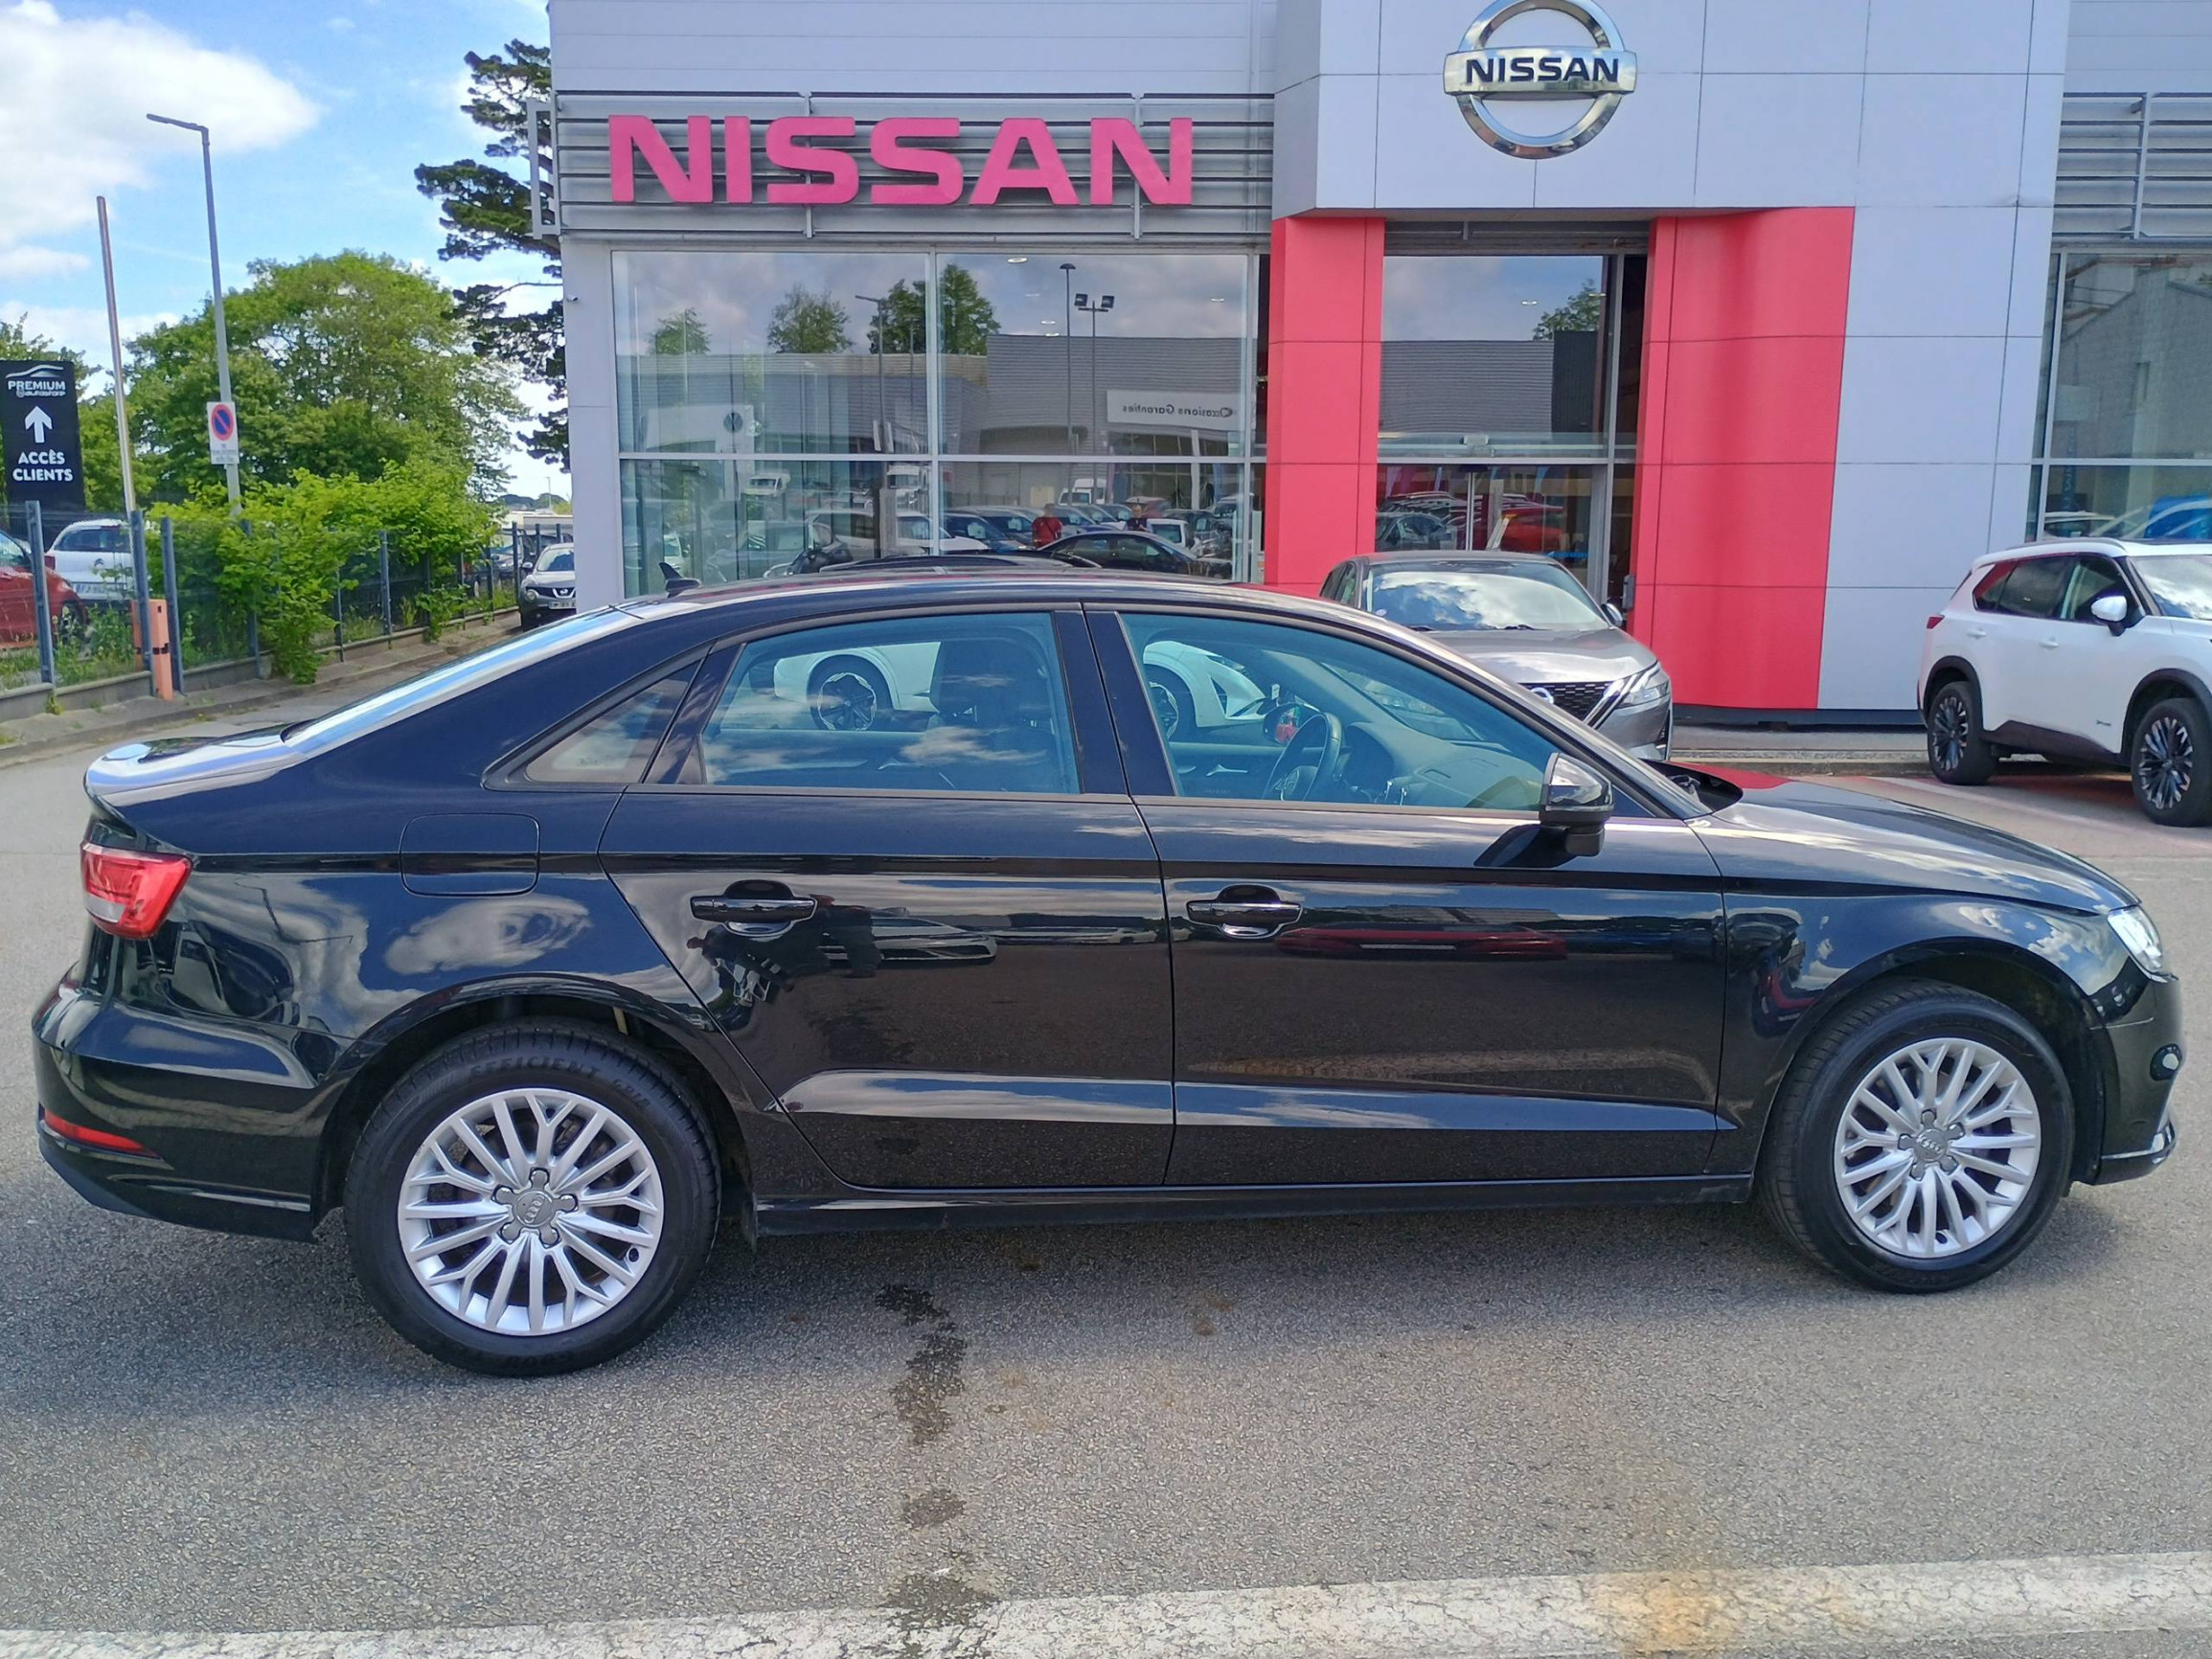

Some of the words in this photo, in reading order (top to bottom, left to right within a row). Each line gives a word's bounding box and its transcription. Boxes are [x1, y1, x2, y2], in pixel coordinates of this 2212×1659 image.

[1467, 57, 1619, 83] NISSAN
[608, 115, 1193, 205] NISSAN
[8, 380, 66, 390] PREMIUM
[18, 449, 65, 465] ACCÈS
[12, 468, 73, 481] CLIENTS
